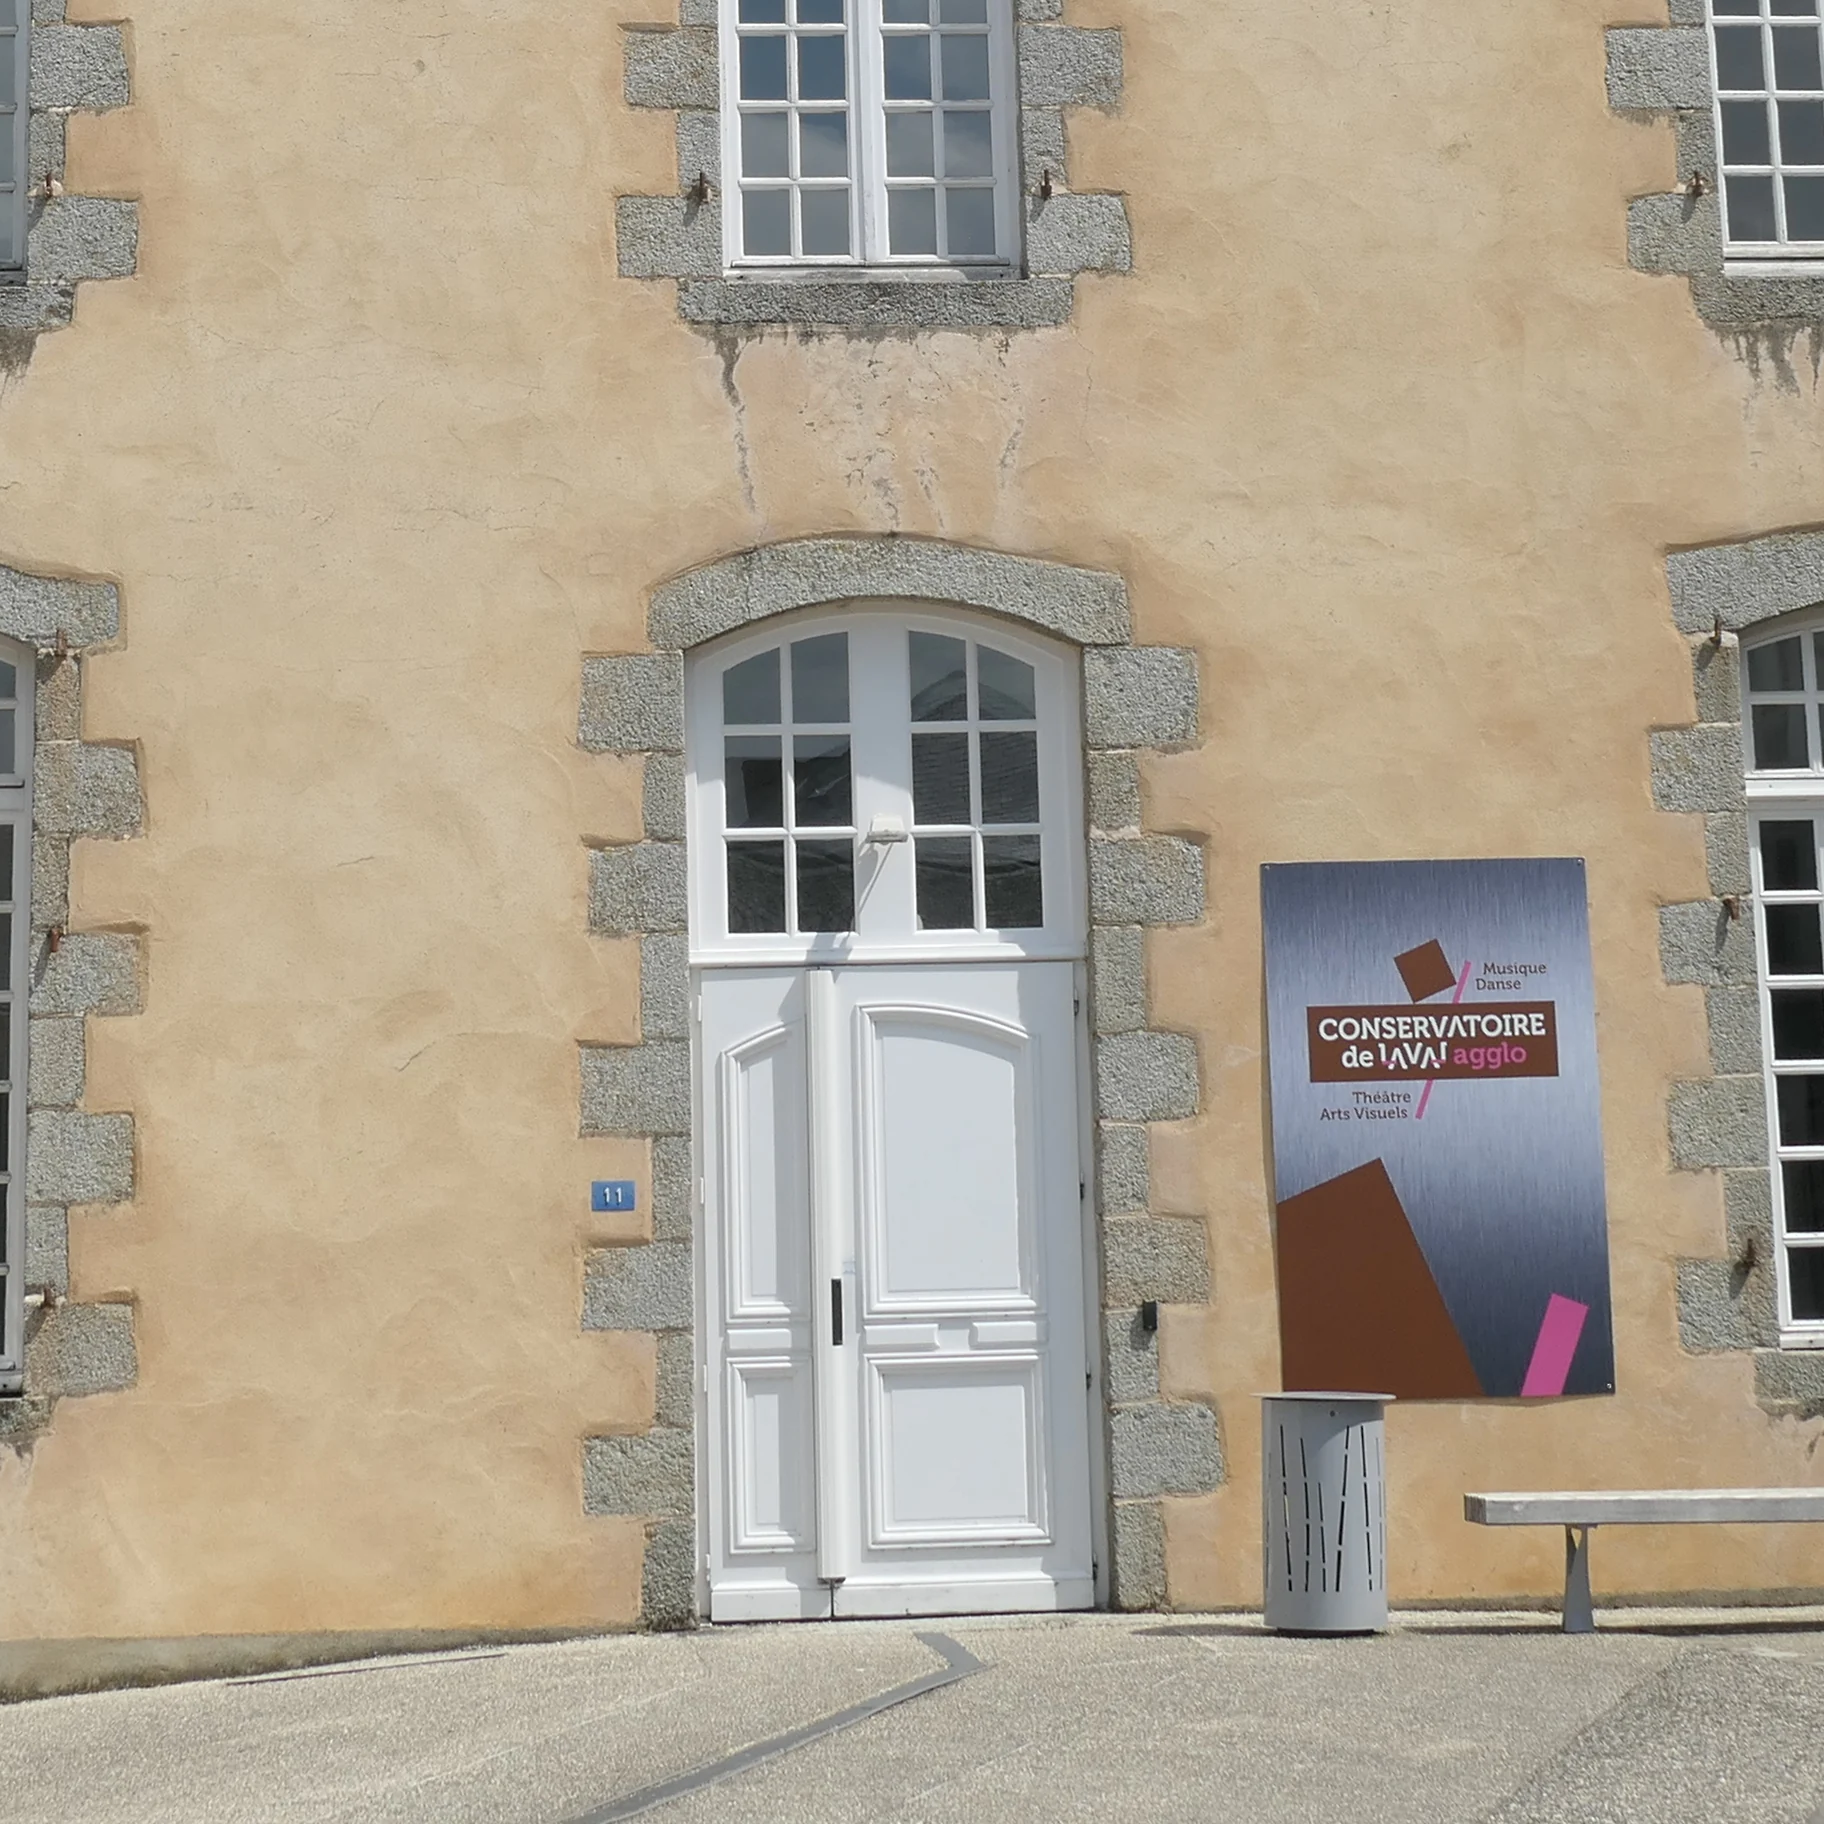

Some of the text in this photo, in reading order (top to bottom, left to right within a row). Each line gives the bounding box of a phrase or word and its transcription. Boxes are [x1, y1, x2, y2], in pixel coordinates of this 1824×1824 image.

[1483, 961, 1547, 977] Musique
[1475, 977, 1522, 991] Danse
[1318, 1013, 1546, 1042] CONSERVATOIRE
[1341, 1045, 1374, 1069] de
[1452, 1041, 1527, 1070] agglo
[1352, 1090, 1411, 1105] Théâtre
[1319, 1106, 1409, 1121] Arts Visuels
[604, 1187, 622, 1203] 11
